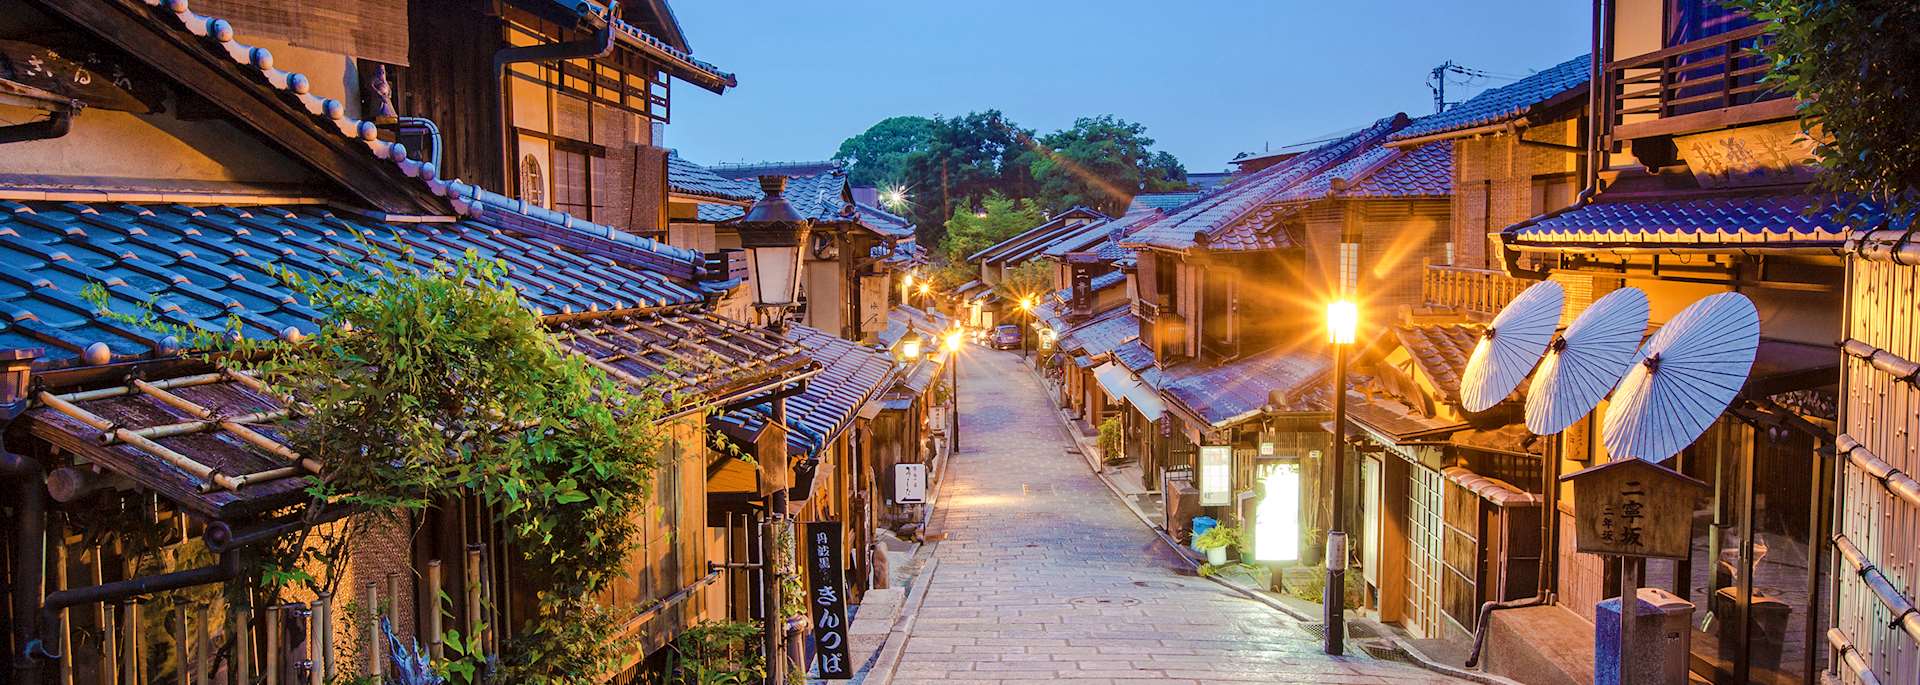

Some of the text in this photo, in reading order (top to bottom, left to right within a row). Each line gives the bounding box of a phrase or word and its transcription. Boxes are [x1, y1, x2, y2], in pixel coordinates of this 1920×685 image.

[1622, 481, 1645, 547] 二寧坂
[817, 585, 842, 673] きんつば
